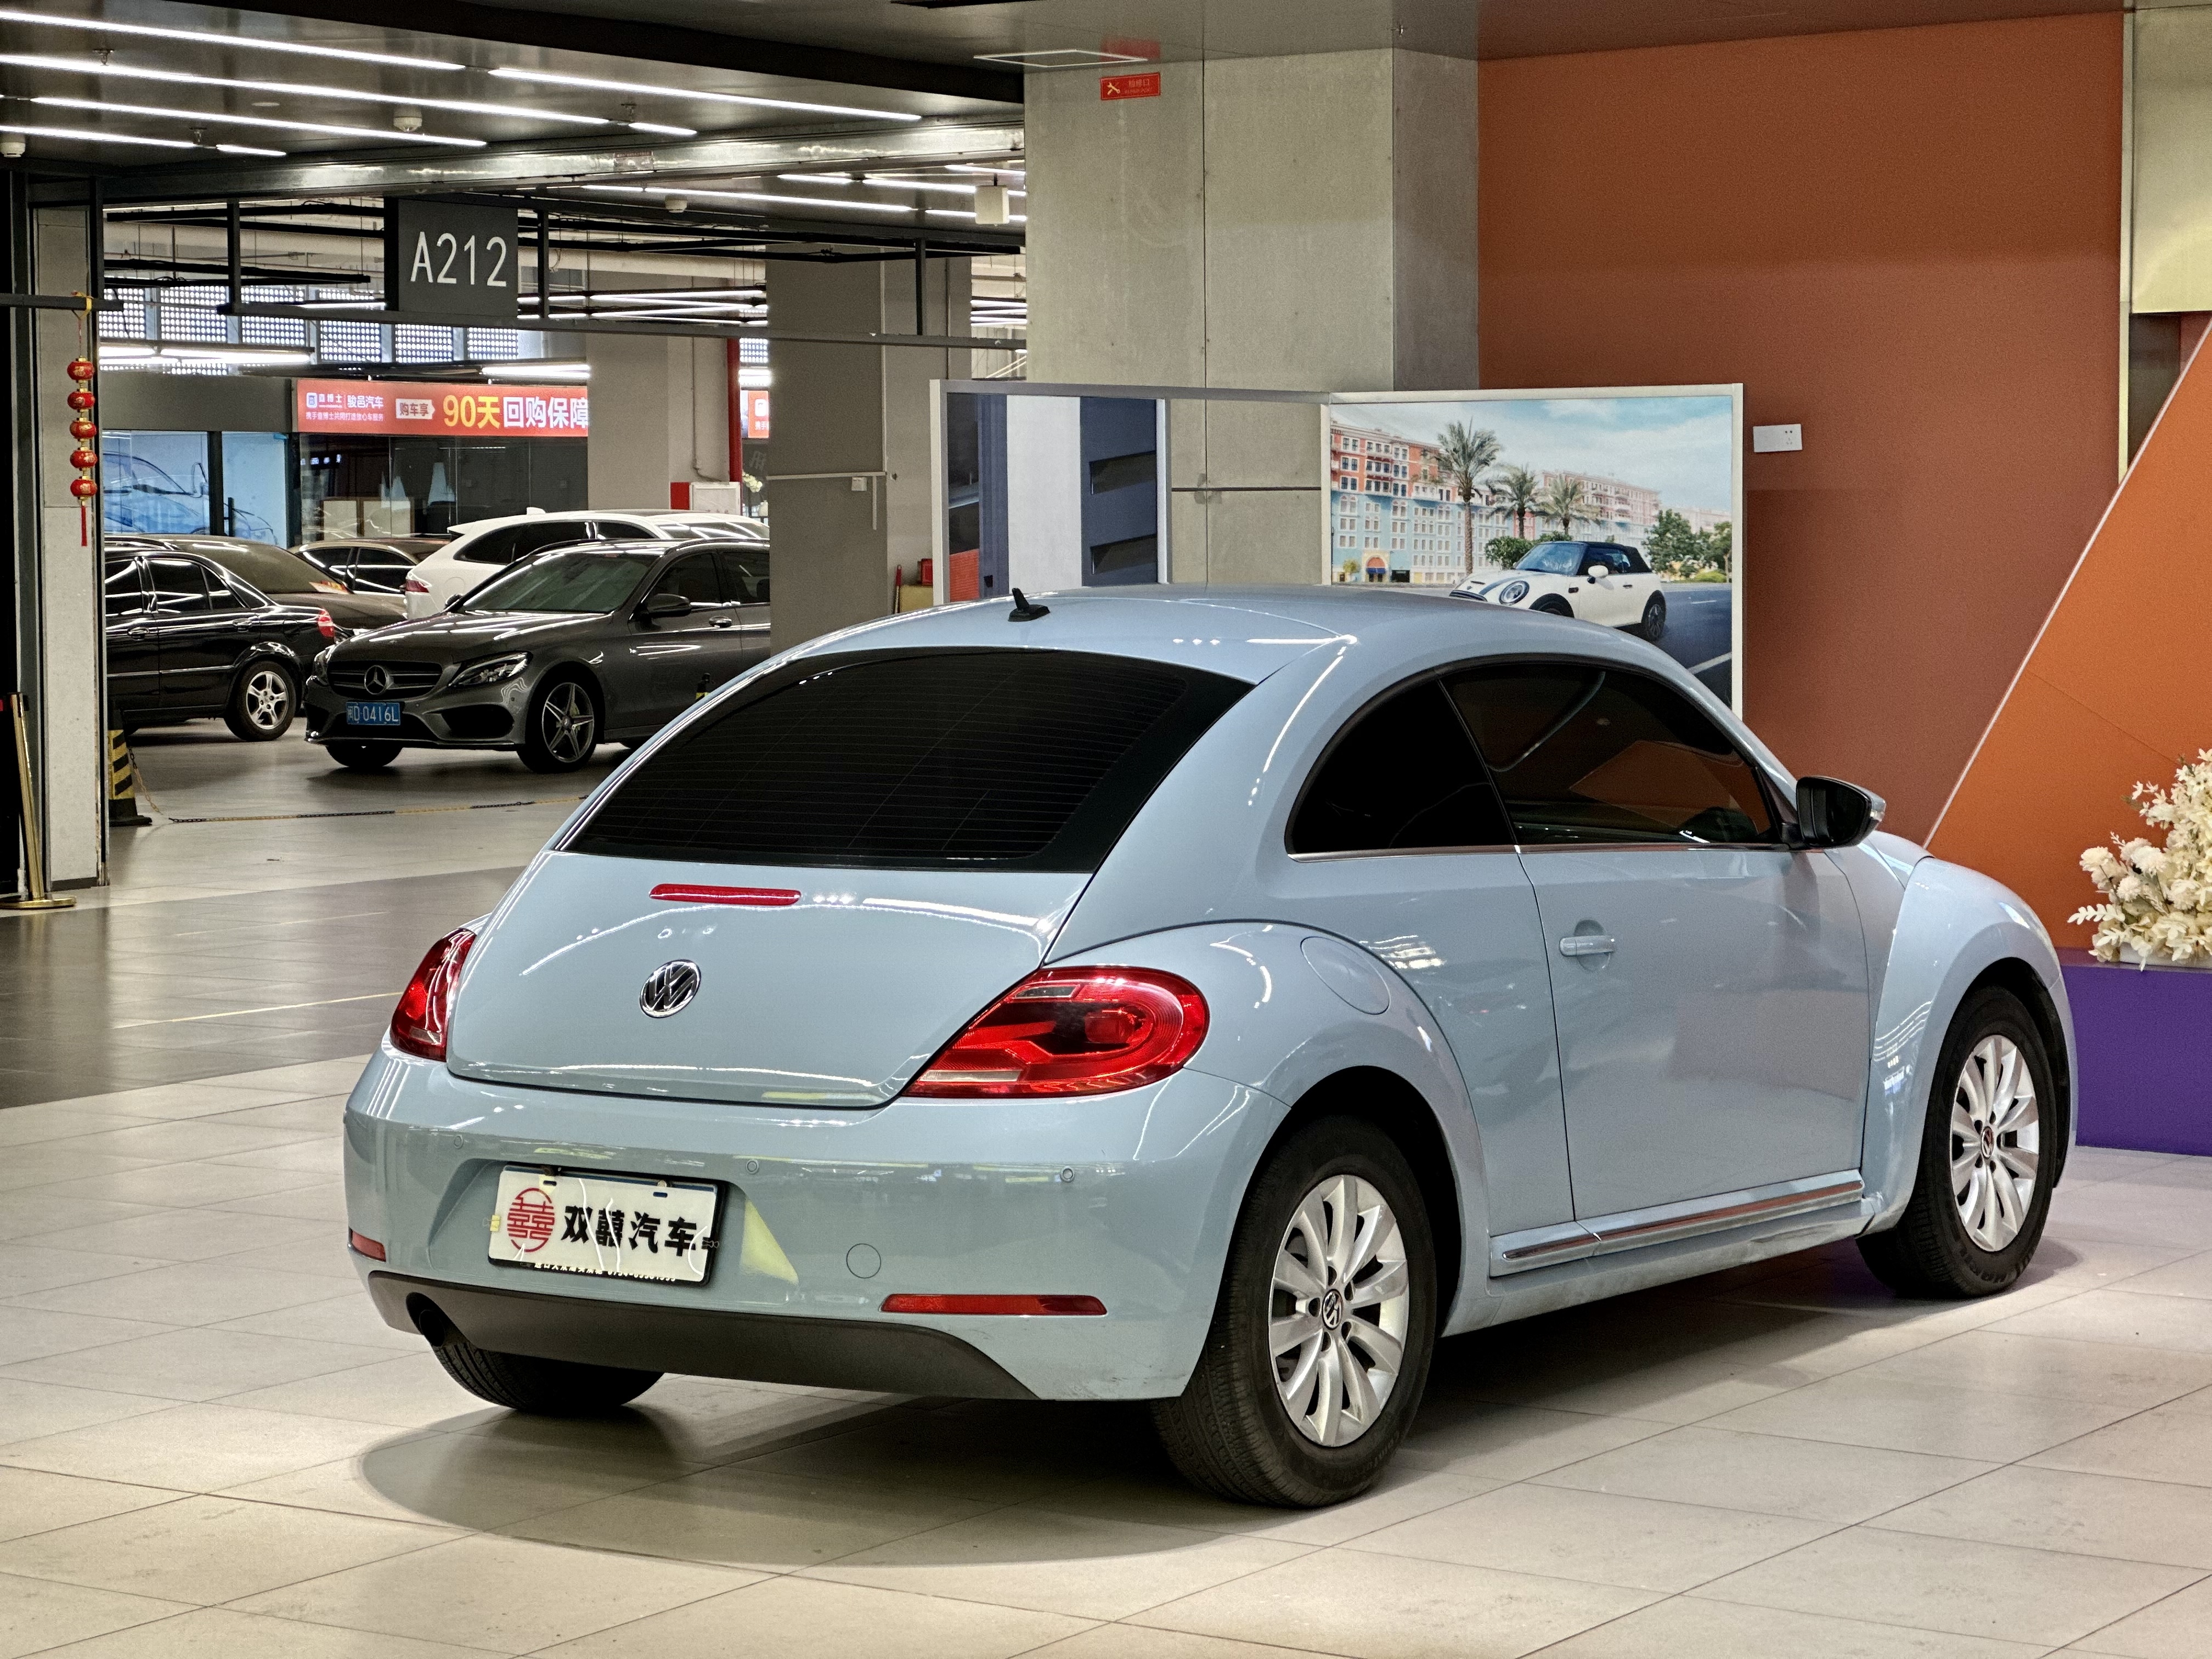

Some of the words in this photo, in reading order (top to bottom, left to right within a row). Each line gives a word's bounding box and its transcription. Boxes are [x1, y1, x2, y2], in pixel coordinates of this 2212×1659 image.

[410, 231, 506, 287] A212
[347, 394, 384, 409] 骏邑汽车
[399, 402, 429, 416] 购车享
